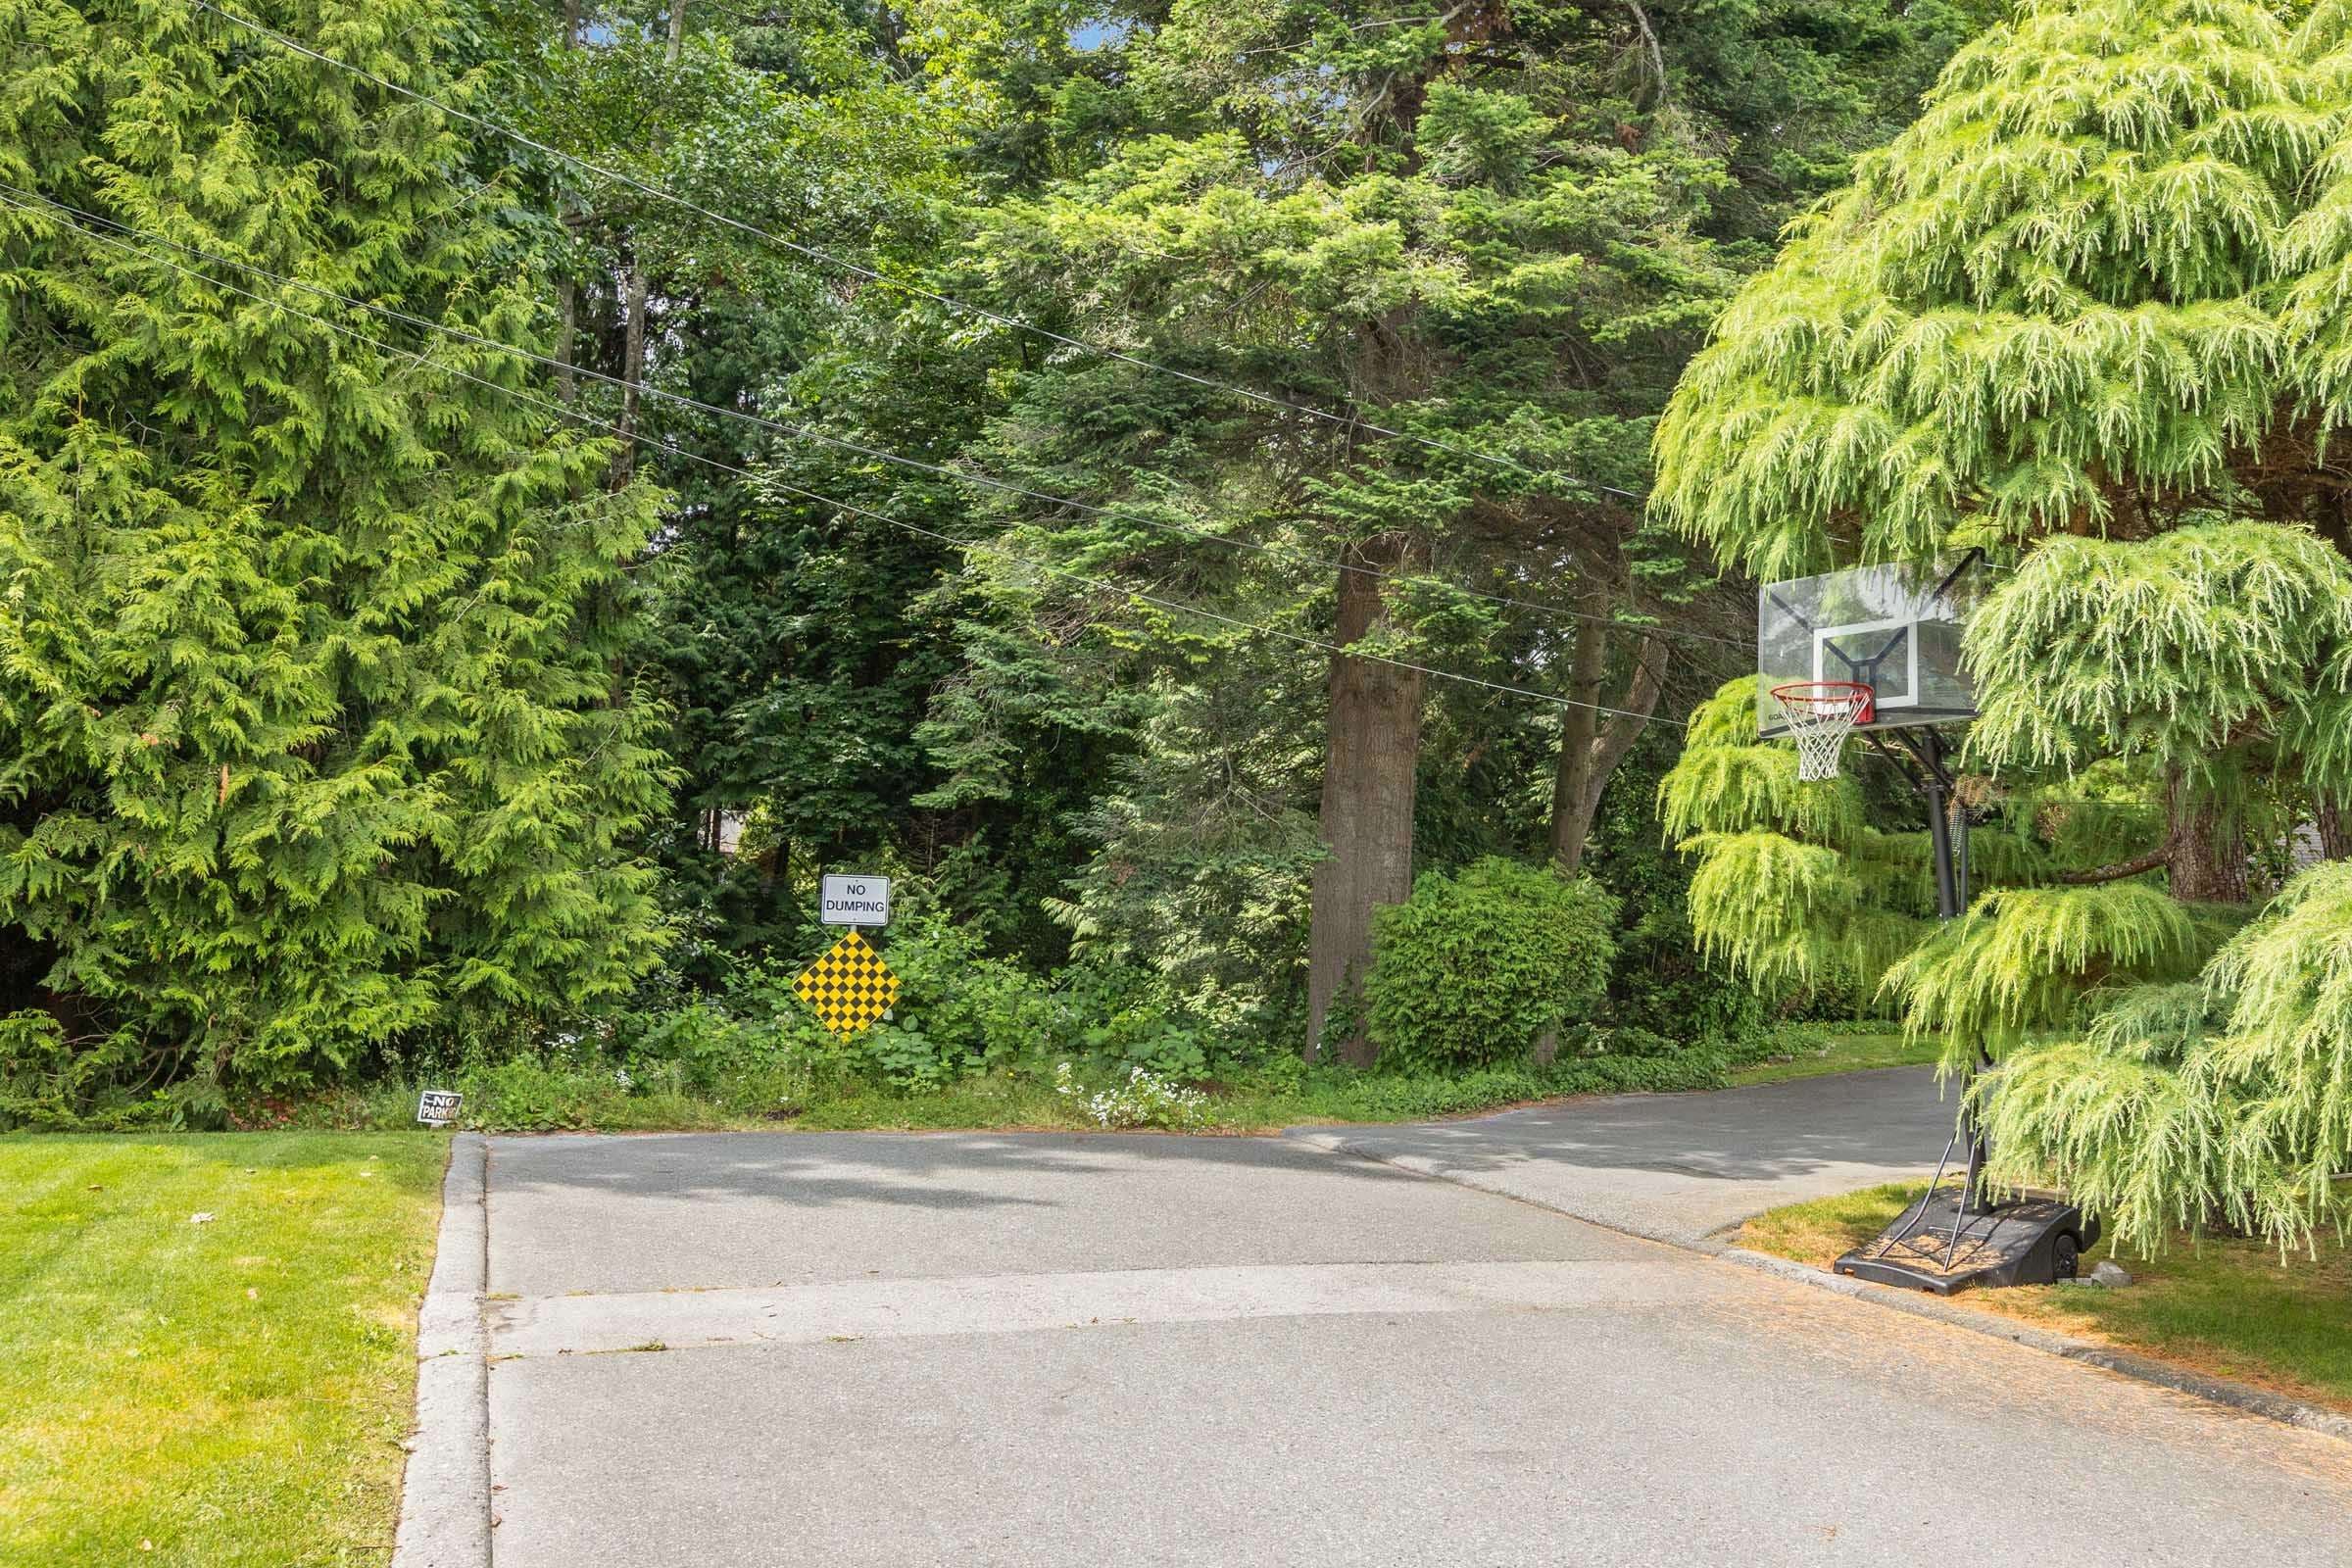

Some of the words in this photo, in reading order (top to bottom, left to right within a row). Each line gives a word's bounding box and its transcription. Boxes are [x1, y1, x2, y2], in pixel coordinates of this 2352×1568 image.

[847, 884, 866, 896] NO
[826, 900, 885, 912] DUMPING
[433, 1096, 455, 1107] NO
